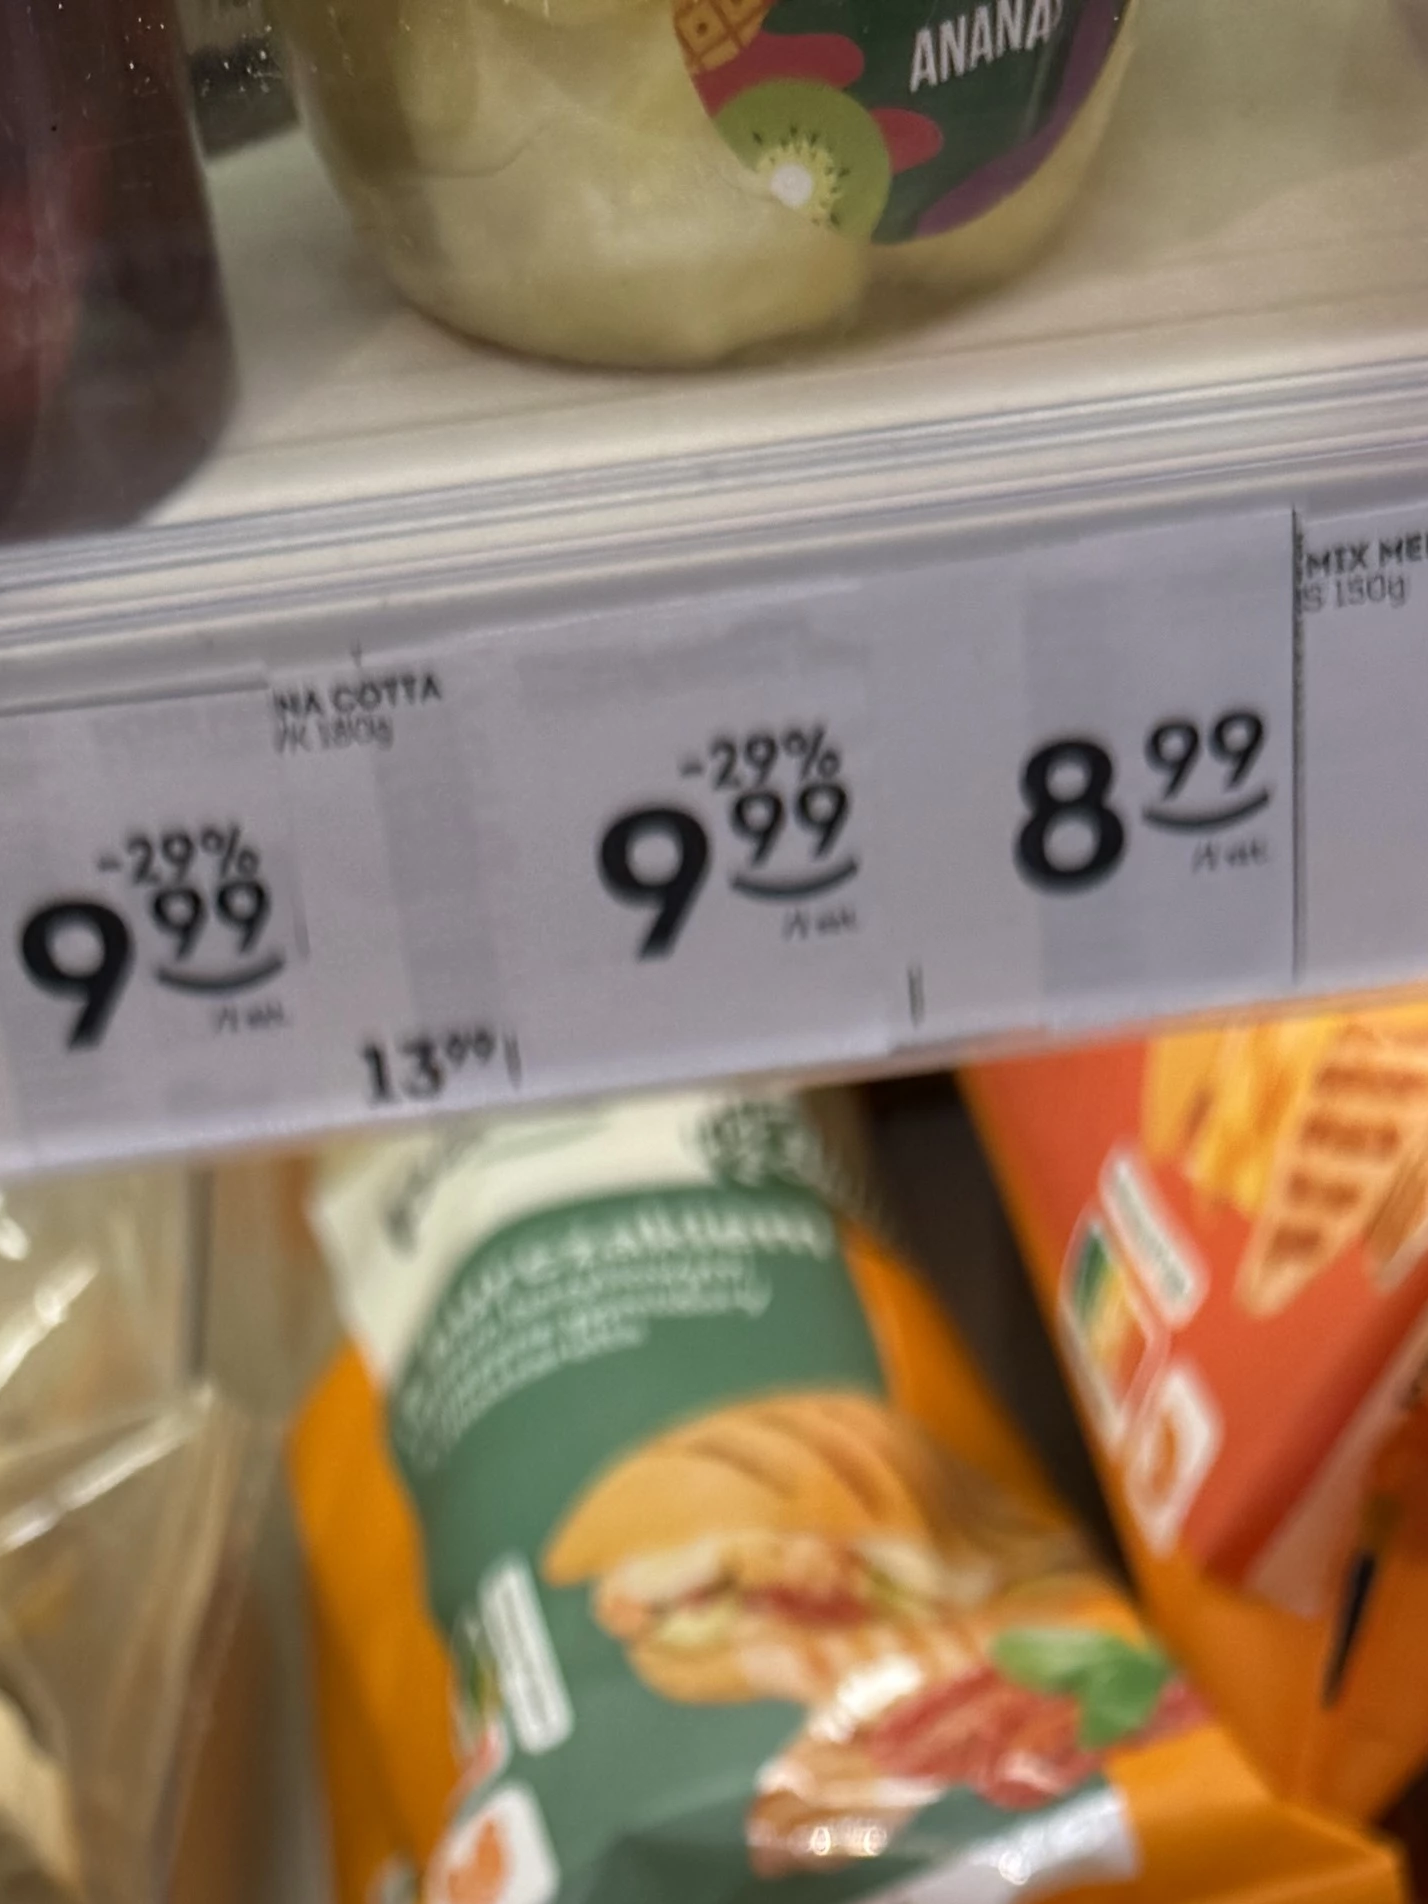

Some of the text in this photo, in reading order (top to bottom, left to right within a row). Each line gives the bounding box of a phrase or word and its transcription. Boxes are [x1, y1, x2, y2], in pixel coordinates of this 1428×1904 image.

[909, 0, 1064, 93] ANANA
[1306, 544, 1370, 578] MIX
[678, 723, 842, 788] -29%
[95, 822, 262, 886] -29%
